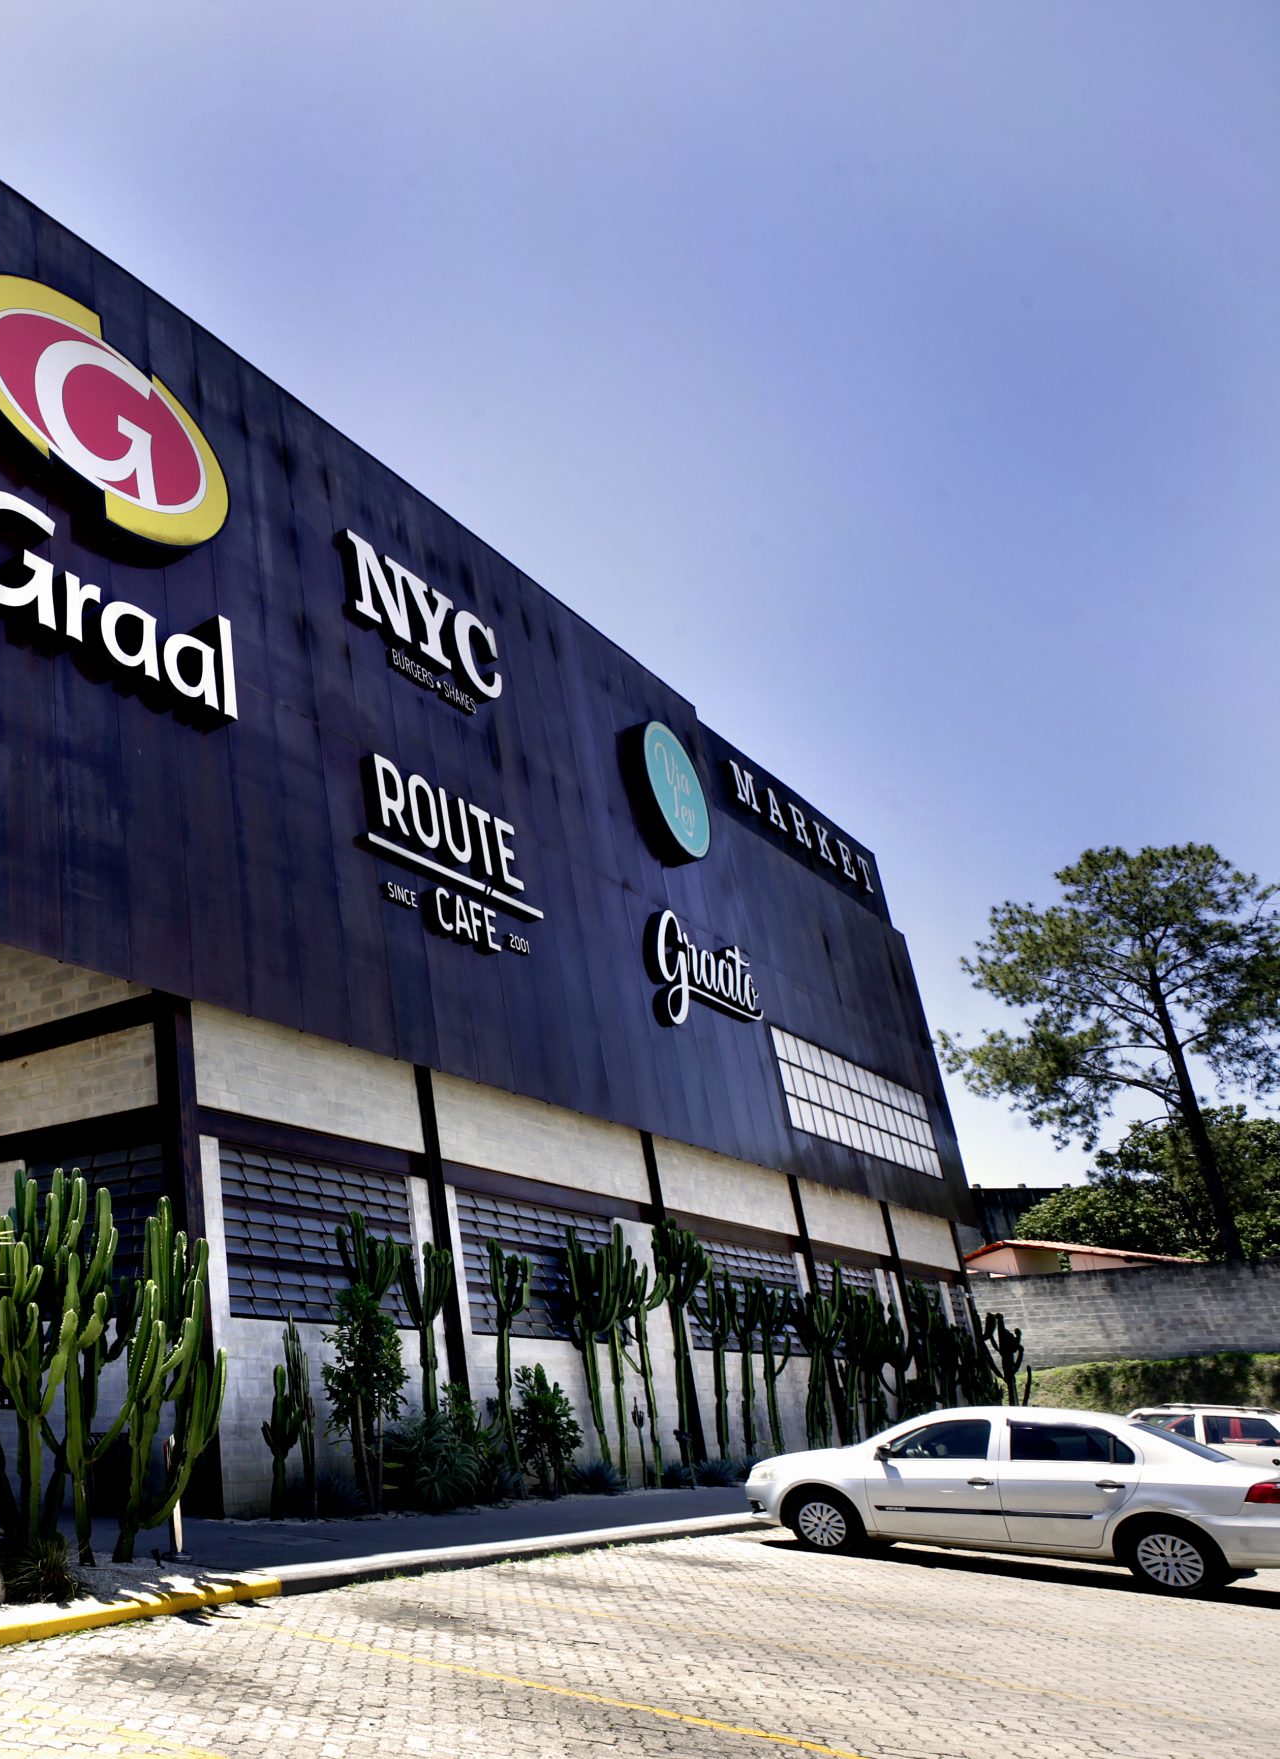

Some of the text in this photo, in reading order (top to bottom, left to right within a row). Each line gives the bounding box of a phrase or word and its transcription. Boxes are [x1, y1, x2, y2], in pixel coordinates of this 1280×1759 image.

[346, 528, 503, 699] NYC
[391, 648, 477, 714] BURGERS SHAKES
[373, 753, 525, 891] ROUTE
[729, 759, 874, 894] MARKET
[387, 881, 418, 908] SINCE
[509, 933, 531, 955] 2001
[657, 909, 764, 1025] Graato
